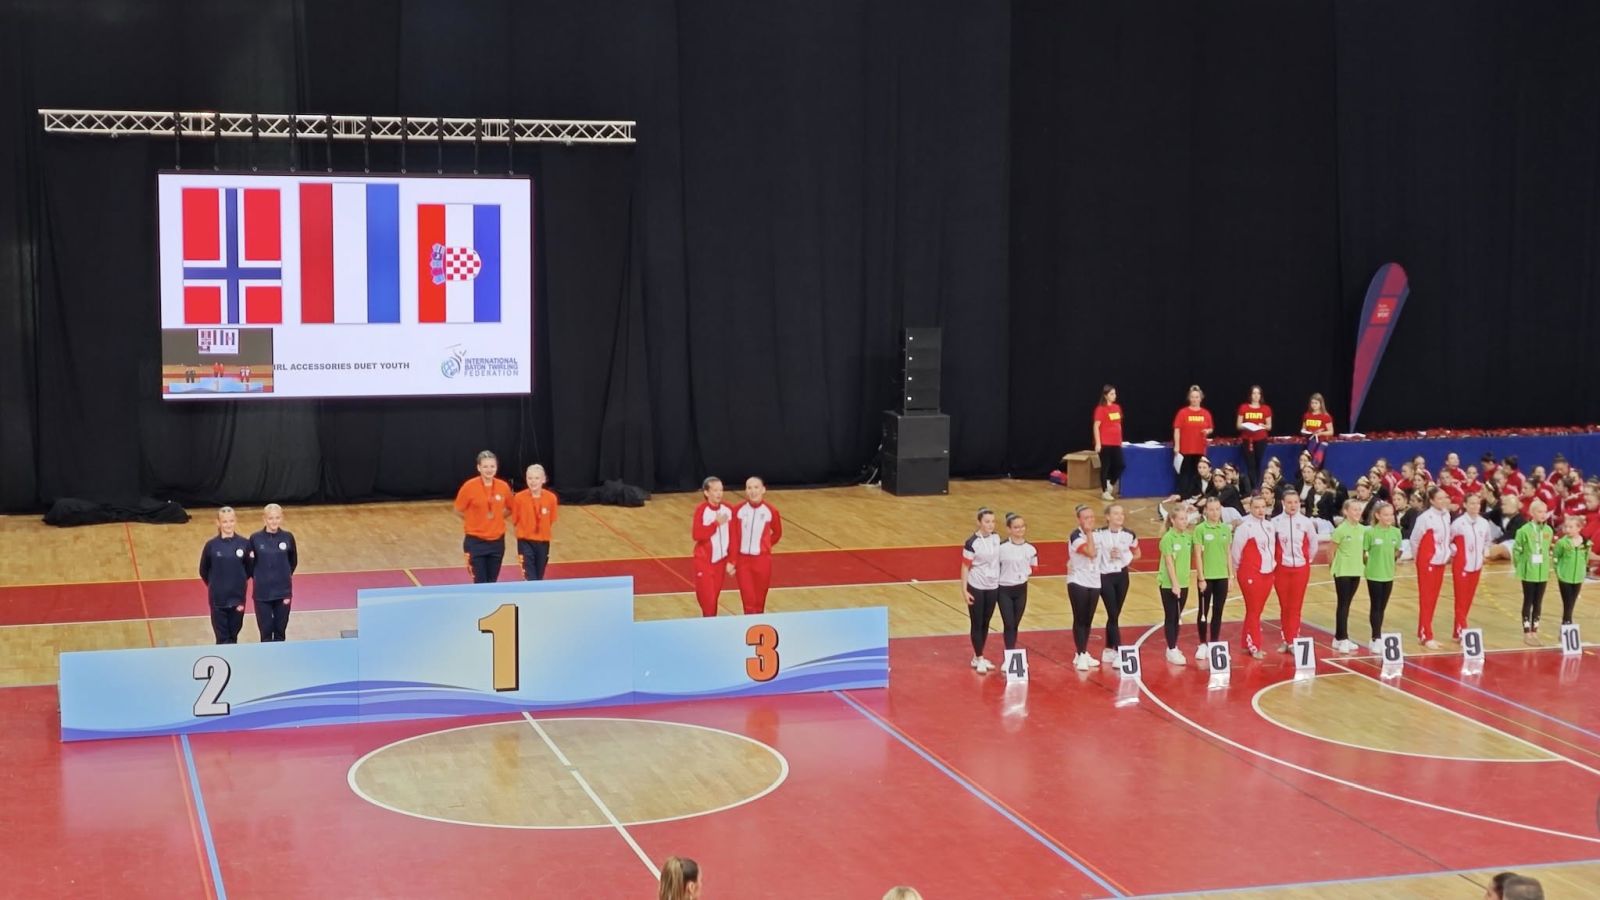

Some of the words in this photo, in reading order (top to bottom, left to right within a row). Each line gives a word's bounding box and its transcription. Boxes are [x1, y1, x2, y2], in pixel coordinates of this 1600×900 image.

[290, 362, 352, 371] ACCESSORIES
[354, 362, 377, 370] DUET
[379, 361, 410, 370] YOUTH
[1245, 412, 1263, 420] STAFF
[1305, 419, 1322, 427] STAFF
[477, 603, 520, 692] 1
[745, 624, 780, 682] 3
[1297, 641, 1310, 666] 7
[1383, 637, 1401, 662] 8
[1465, 632, 1482, 657] 9
[1562, 630, 1580, 652] 10
[1008, 653, 1026, 678] 4
[1120, 650, 1139, 675] 5
[1210, 645, 1229, 671] 6
[192, 655, 231, 717] 2
